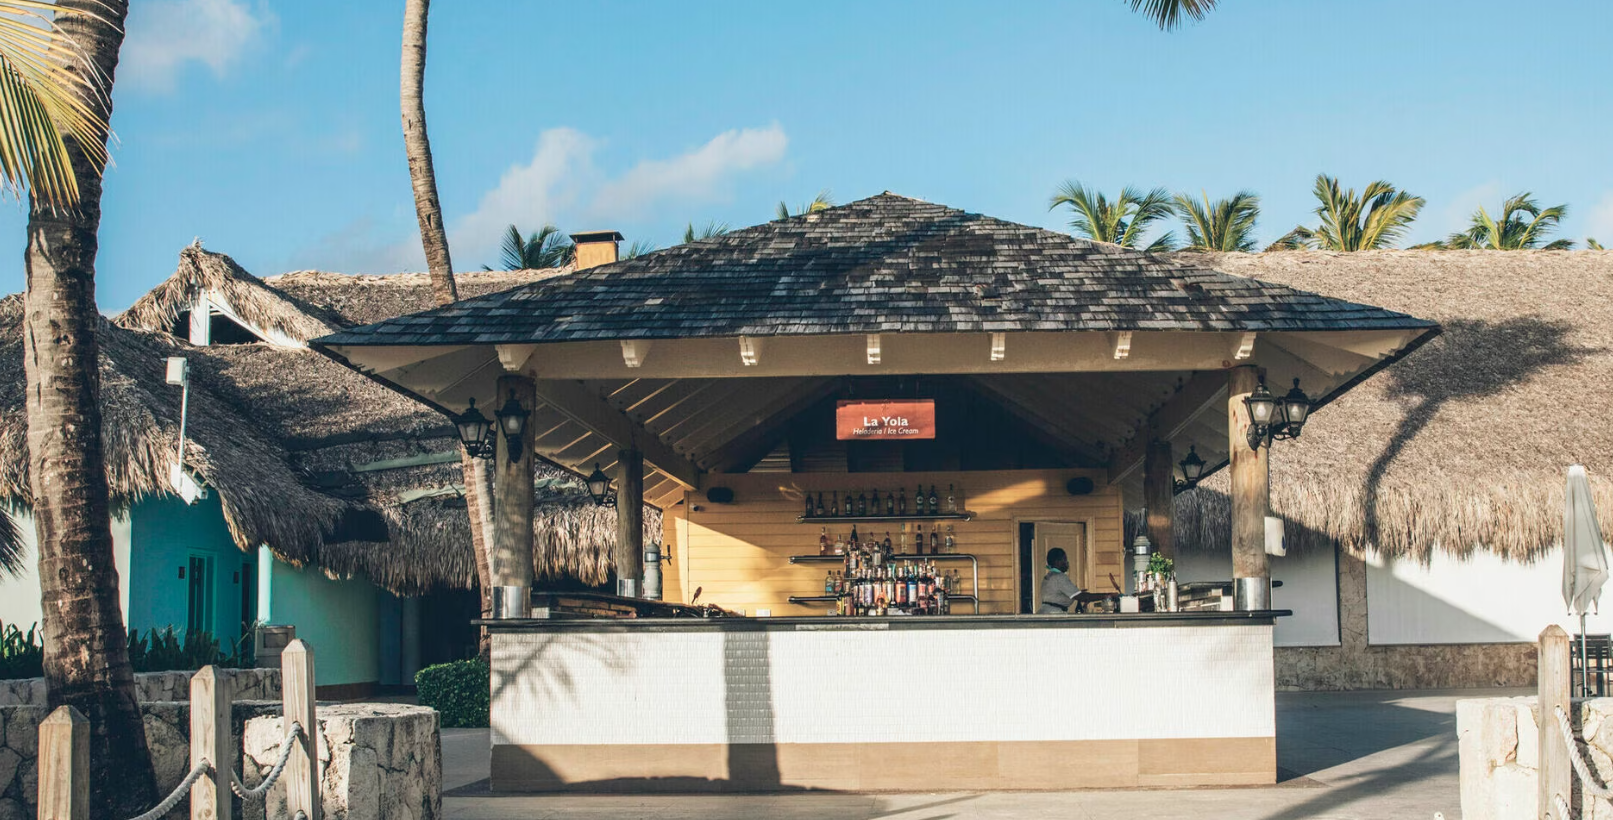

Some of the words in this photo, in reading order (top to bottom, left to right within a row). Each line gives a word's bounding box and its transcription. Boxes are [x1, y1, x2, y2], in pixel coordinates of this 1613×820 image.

[863, 416, 878, 427] La
[881, 416, 909, 427] Yola
[887, 427, 897, 435] Ice
[898, 427, 919, 435] Cream
